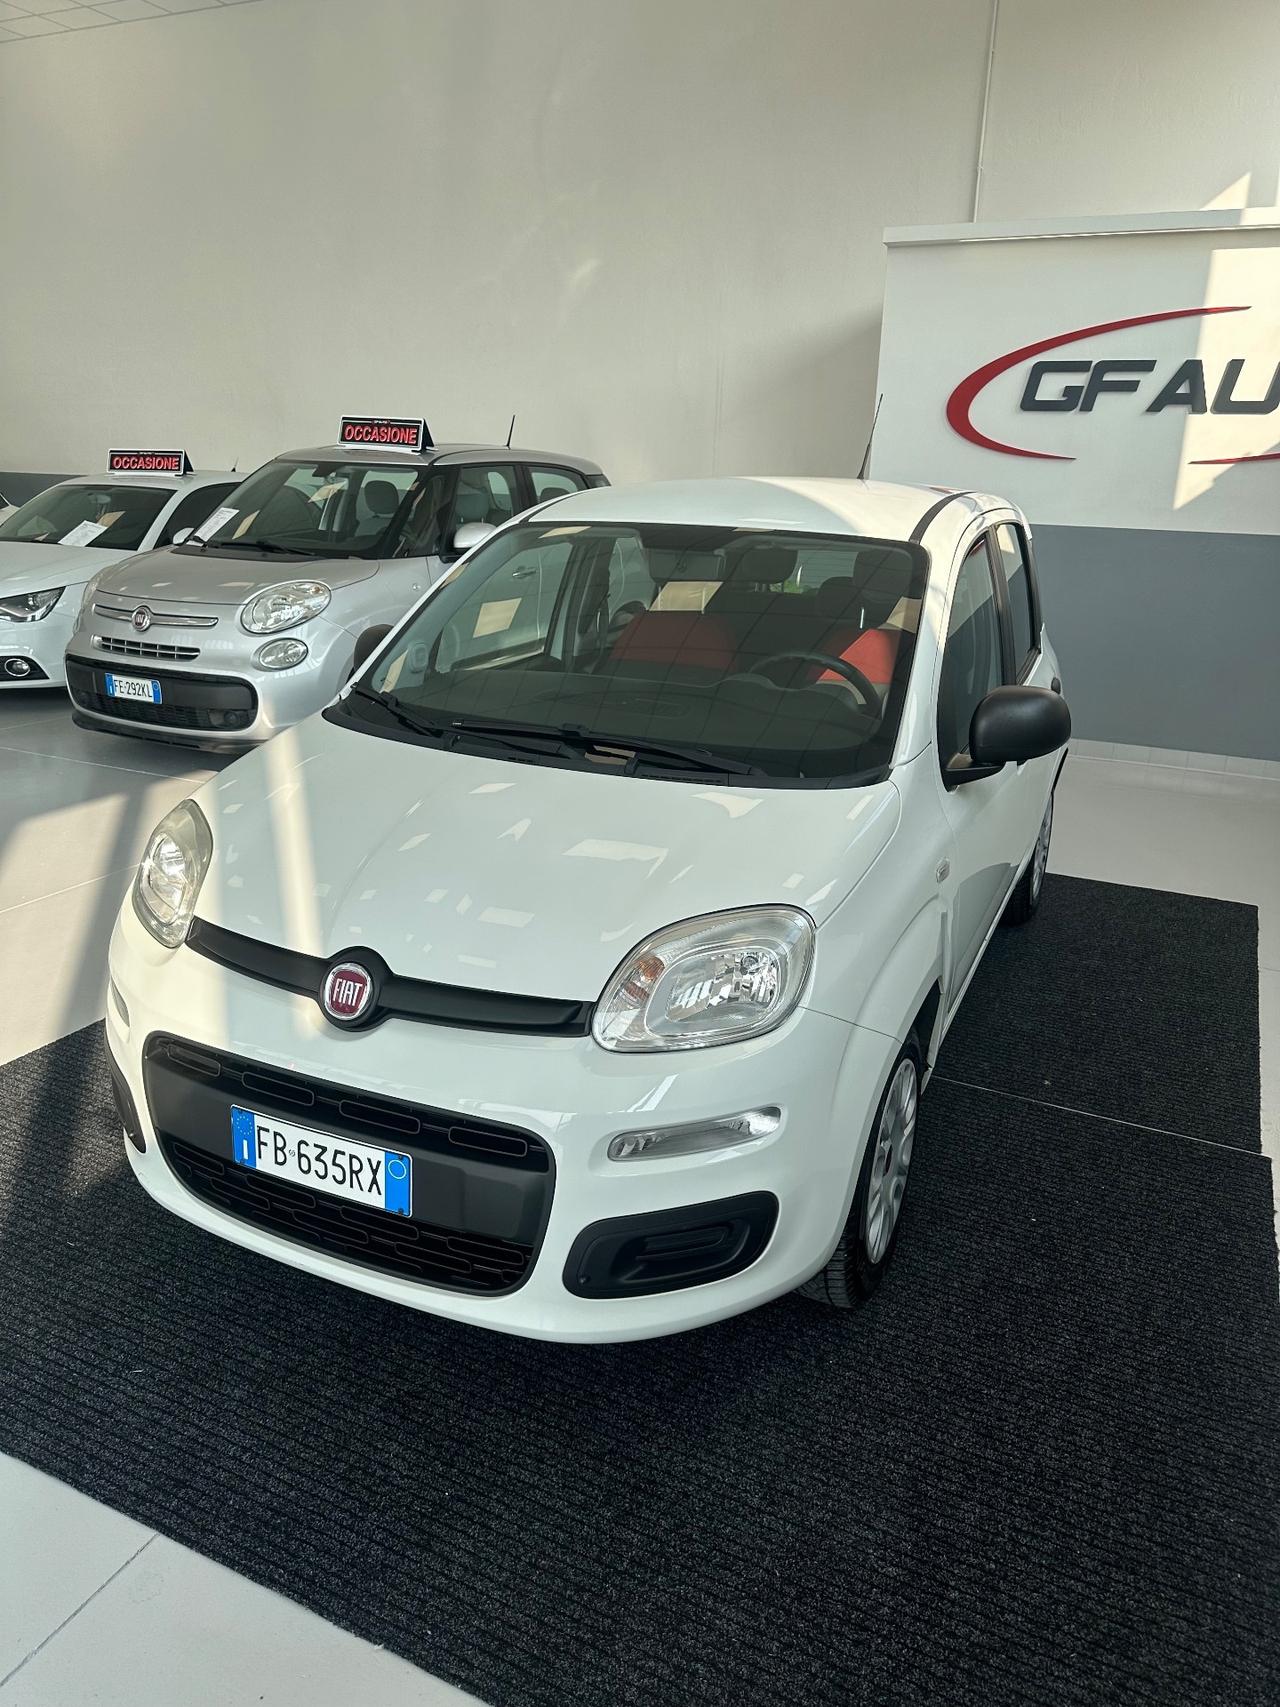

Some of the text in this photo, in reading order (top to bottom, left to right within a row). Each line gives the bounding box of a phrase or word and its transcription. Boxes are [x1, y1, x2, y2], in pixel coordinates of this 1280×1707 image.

[344, 424, 418, 445] OCCASIONE
[112, 455, 180, 470] OCCASIONE
[332, 978, 363, 1007] FIAT
